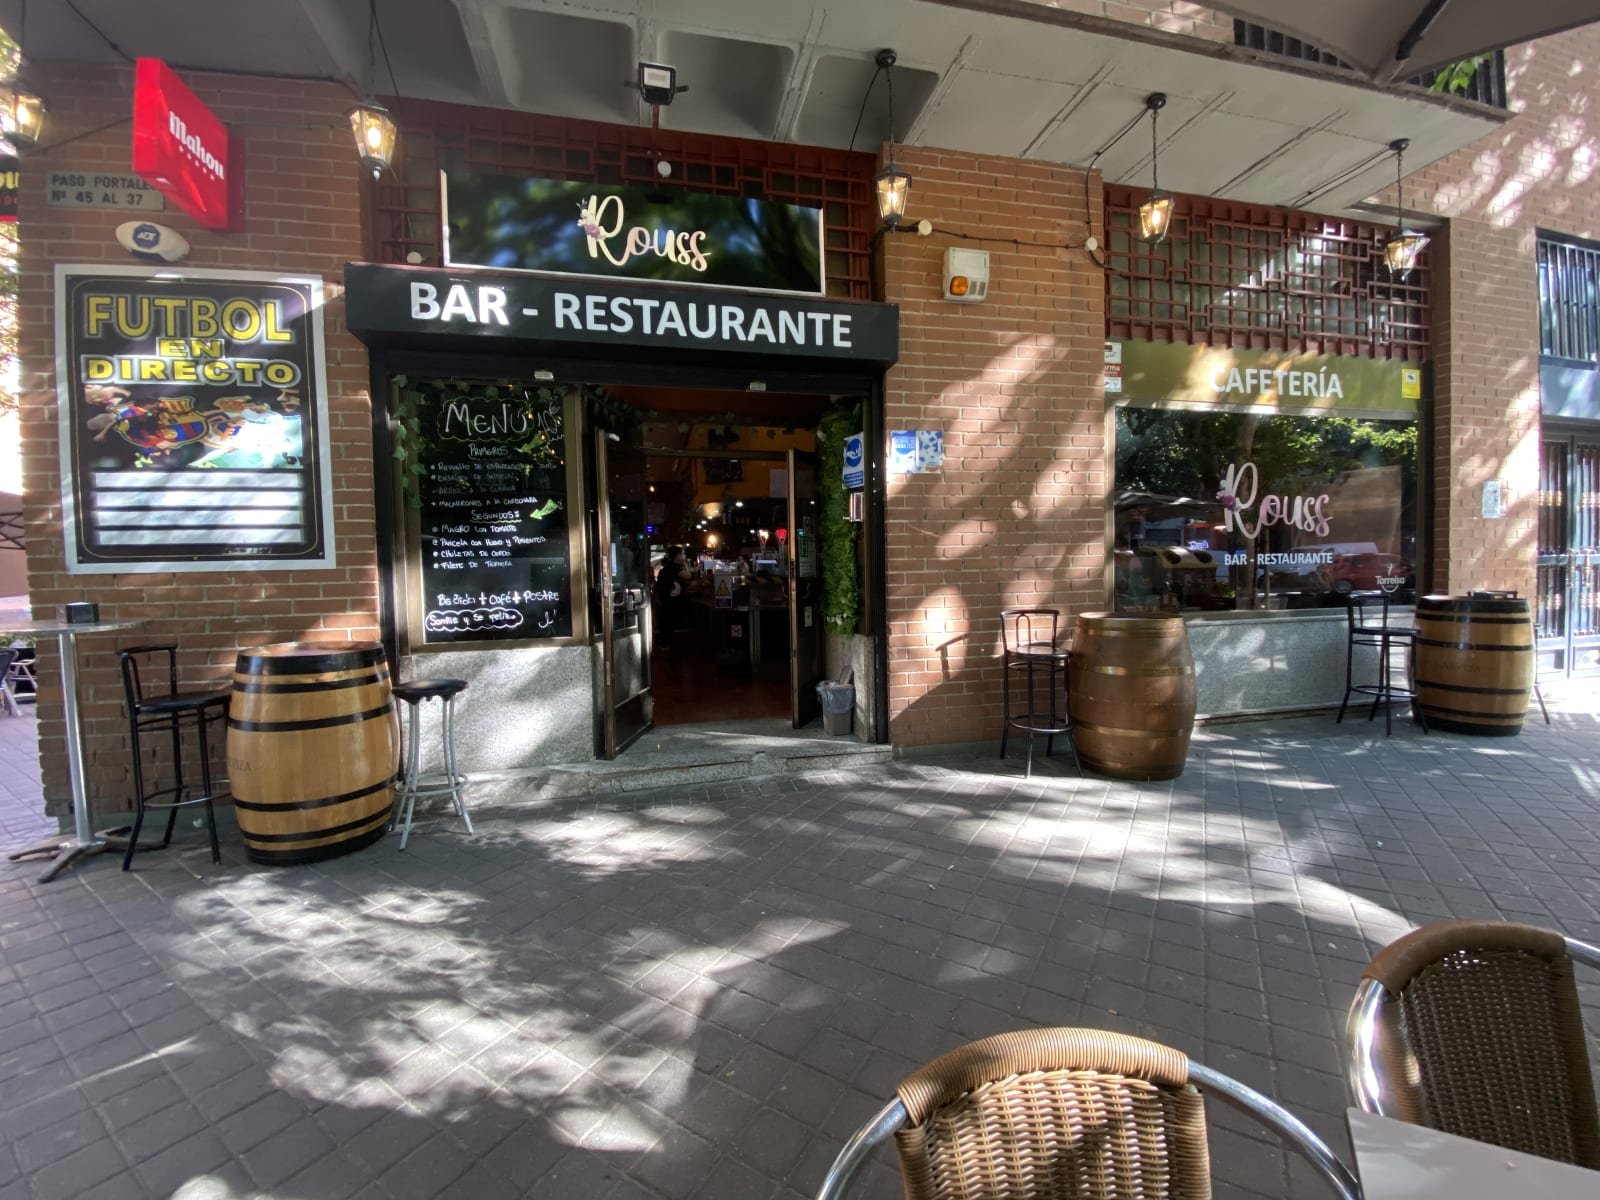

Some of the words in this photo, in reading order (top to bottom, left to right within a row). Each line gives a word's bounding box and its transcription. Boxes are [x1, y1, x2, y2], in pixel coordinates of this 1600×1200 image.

[169, 111, 224, 180] Mahou
[52, 174, 85, 187] PASO
[94, 175, 154, 191] PORTALE
[75, 191, 93, 203] 45
[102, 193, 118, 204] AL
[127, 194, 143, 206] 37
[137, 231, 157, 241] ADT
[580, 194, 712, 272] Rouss
[86, 295, 293, 342] FUTBOL
[410, 281, 510, 326] BAR
[554, 292, 852, 348] RESTAURANTE
[158, 338, 221, 358] EN
[87, 358, 295, 384] DIRECTO
[1211, 366, 1344, 399] CAFETERÍA
[1219, 462, 1334, 539] Rouss
[1224, 554, 1248, 566] BAR
[1257, 552, 1333, 565] RESTAURANTE
